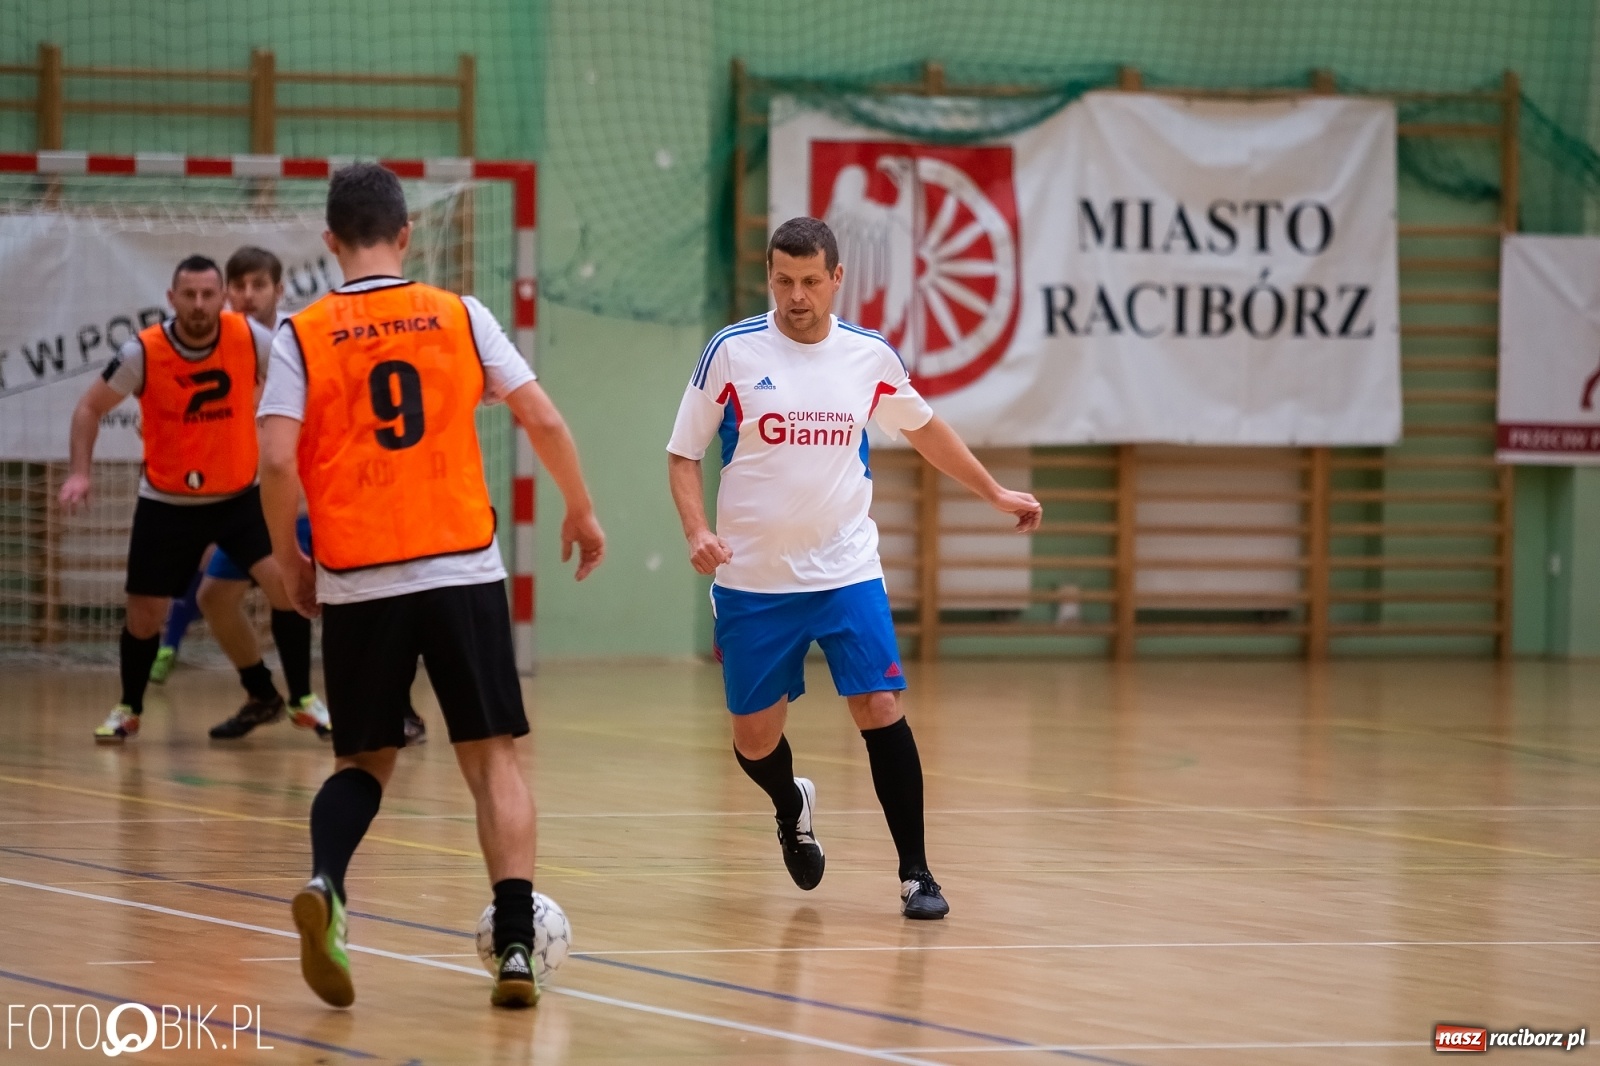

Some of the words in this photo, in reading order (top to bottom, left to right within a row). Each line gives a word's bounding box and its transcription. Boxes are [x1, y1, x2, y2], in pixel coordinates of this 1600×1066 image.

[1076, 198, 1334, 256] MIASTO
[1040, 267, 1376, 339] RACIBÓRZ
[354, 316, 442, 340] PATRICK
[21, 333, 64, 378] W
[368, 359, 426, 450] 9
[788, 411, 854, 423] CUKIERNIA
[758, 412, 853, 447] Gianni
